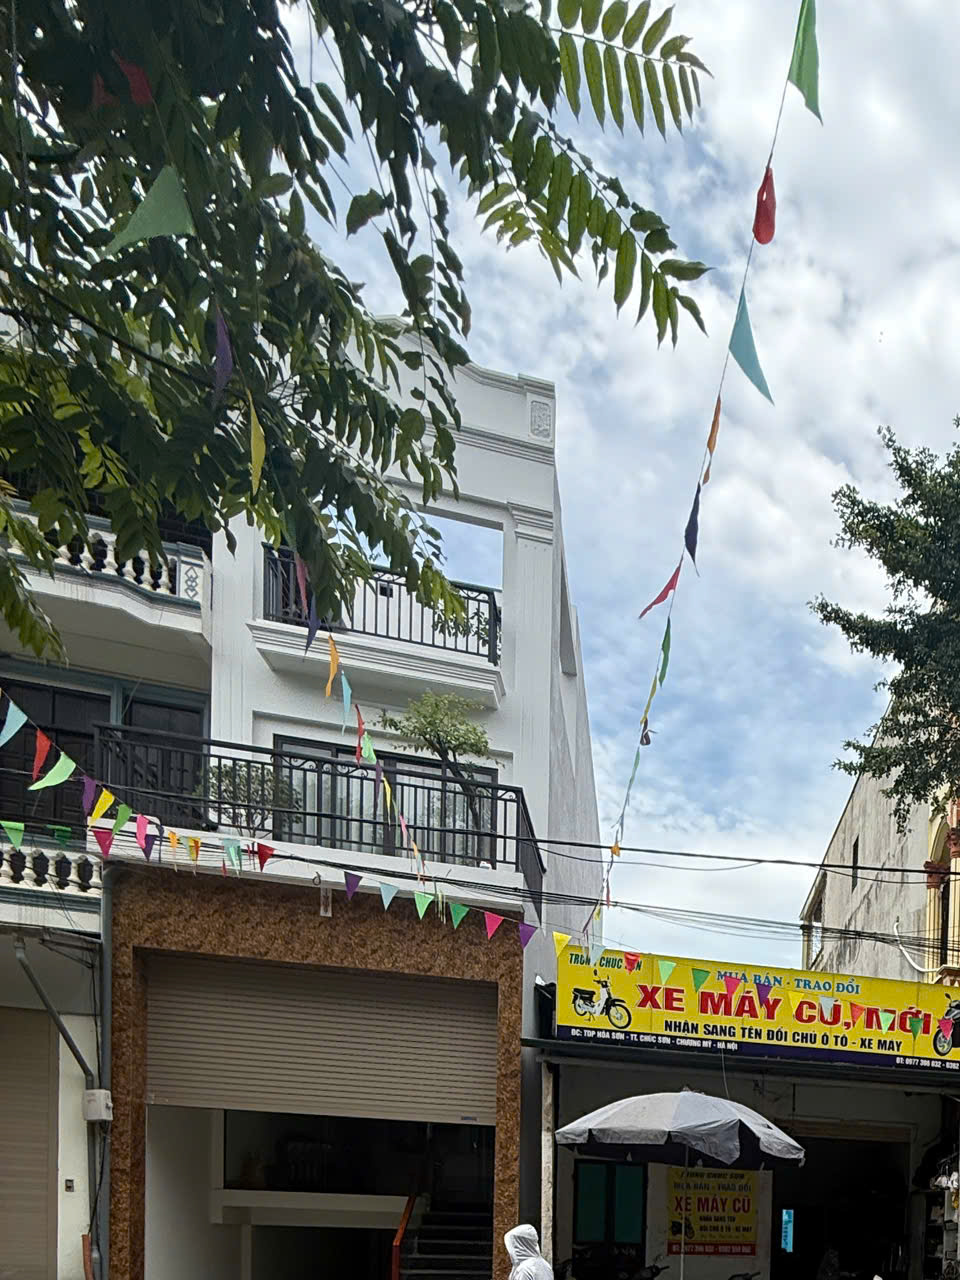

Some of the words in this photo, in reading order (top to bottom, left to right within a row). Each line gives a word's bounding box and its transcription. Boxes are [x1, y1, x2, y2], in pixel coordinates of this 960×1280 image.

[753, 972, 782, 987] BÁN
[794, 978, 832, 991] TRAO
[836, 979, 860, 994] ĐỔI
[637, 984, 684, 1012] XE
[699, 990, 782, 1020] MÁY
[584, 1029, 596, 1037] TDP
[611, 1032, 625, 1040] SƠN
[664, 1018, 699, 1035] NHẬN
[703, 1024, 736, 1037] SANG
[741, 1026, 762, 1039] TÊN
[792, 1030, 817, 1044] CHỦ
[821, 1032, 829, 1045] Ô
[833, 1034, 848, 1047] TÔ
[860, 1037, 873, 1049] XE
[674, 1196, 692, 1212] XE
[697, 1193, 728, 1213] MÁY
